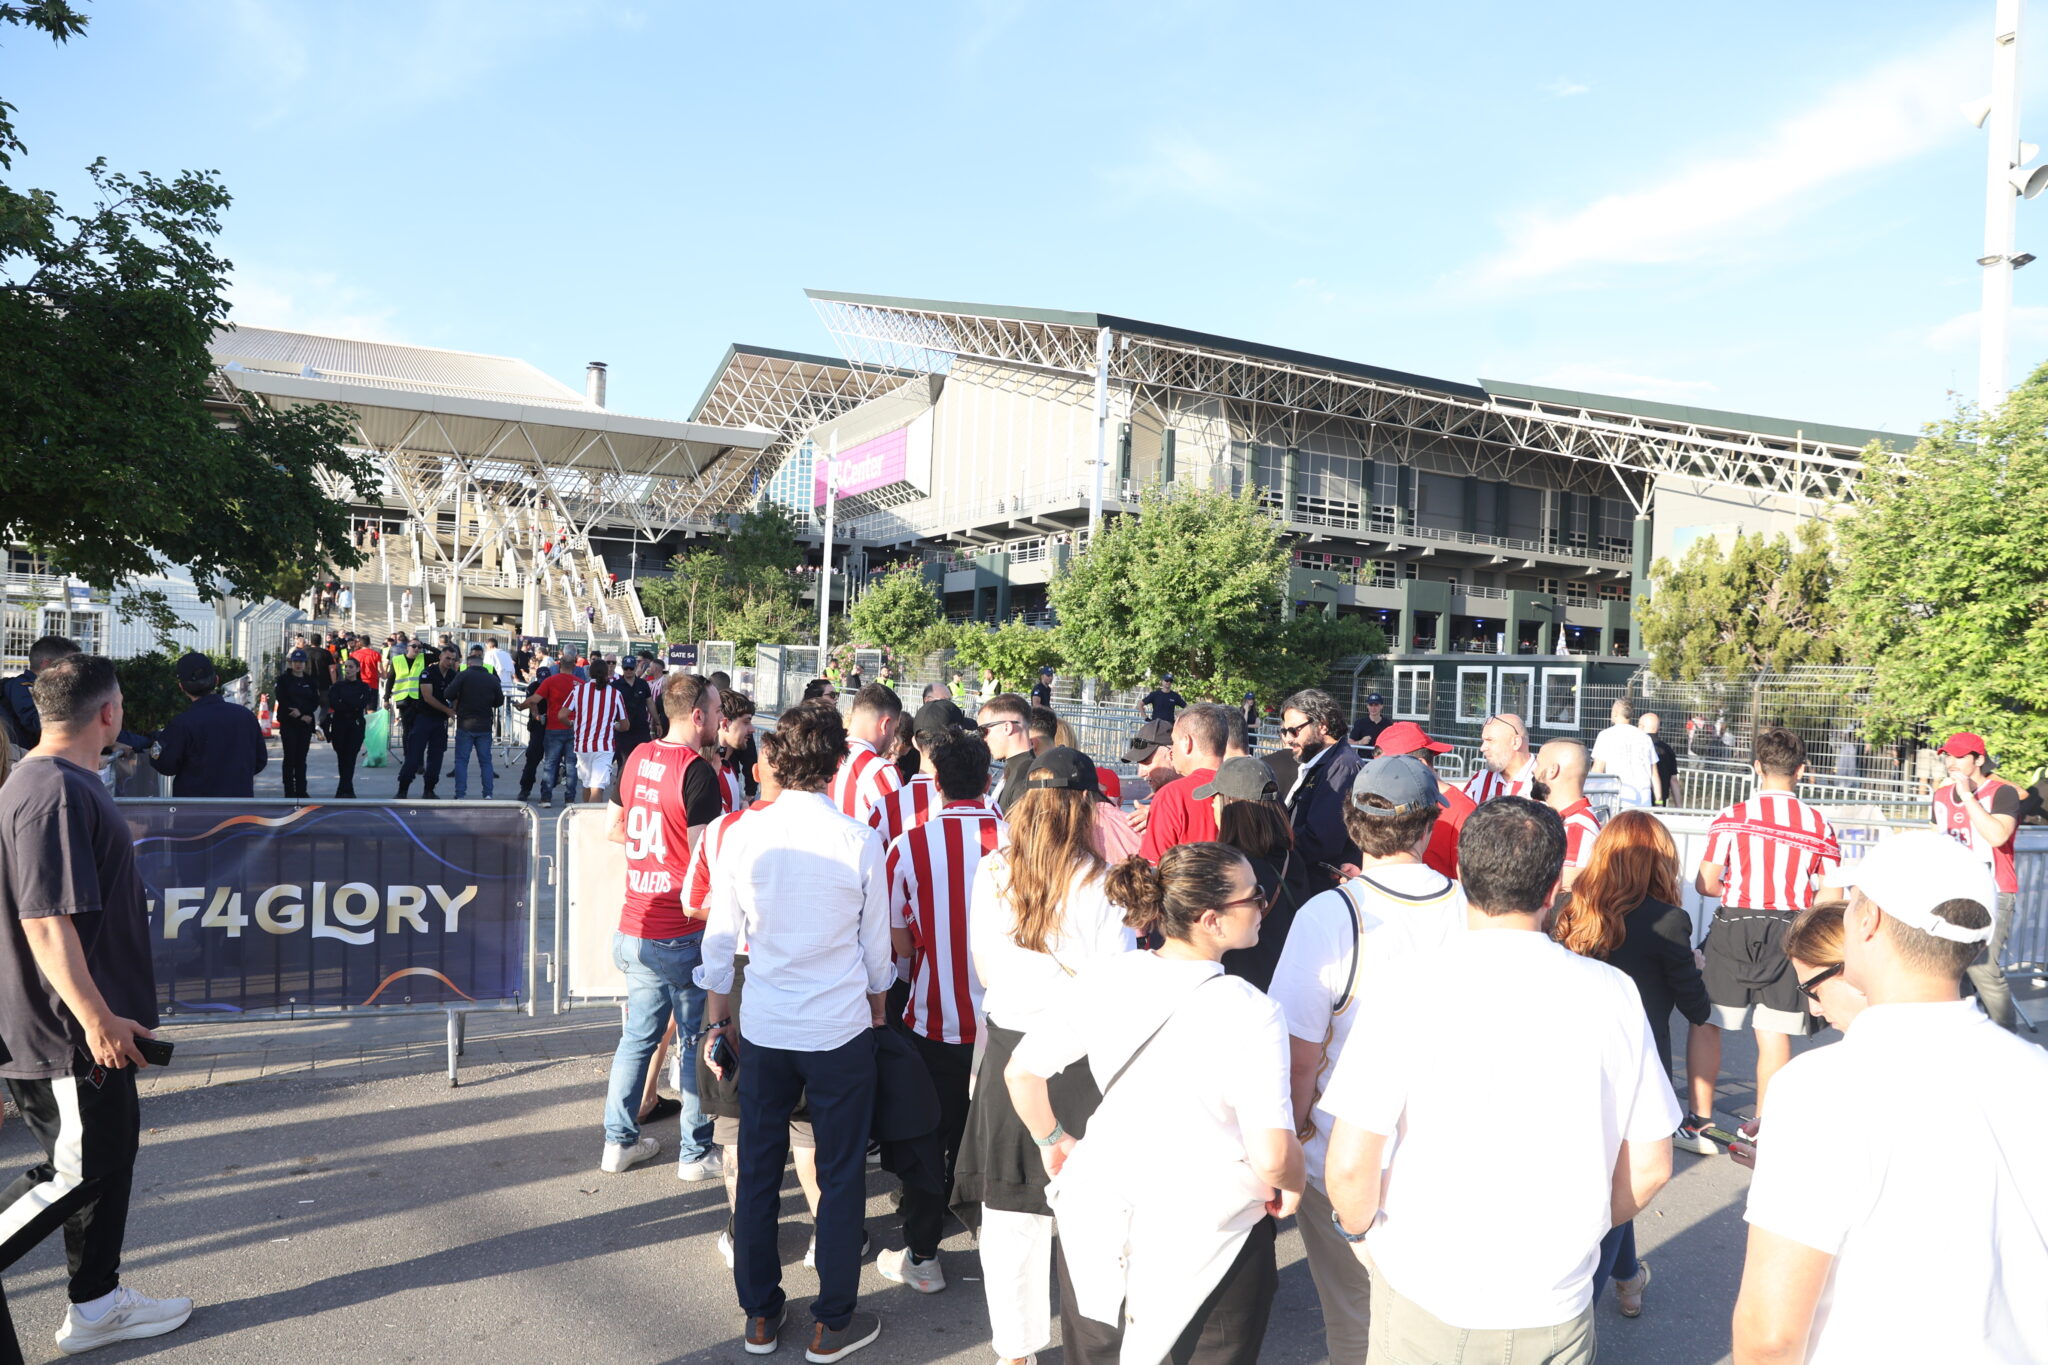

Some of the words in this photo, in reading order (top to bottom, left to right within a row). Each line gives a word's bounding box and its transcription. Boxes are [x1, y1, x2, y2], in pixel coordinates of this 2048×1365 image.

[843, 454, 885, 488] Center
[670, 651, 686, 659] GATE
[625, 805, 667, 864] 94
